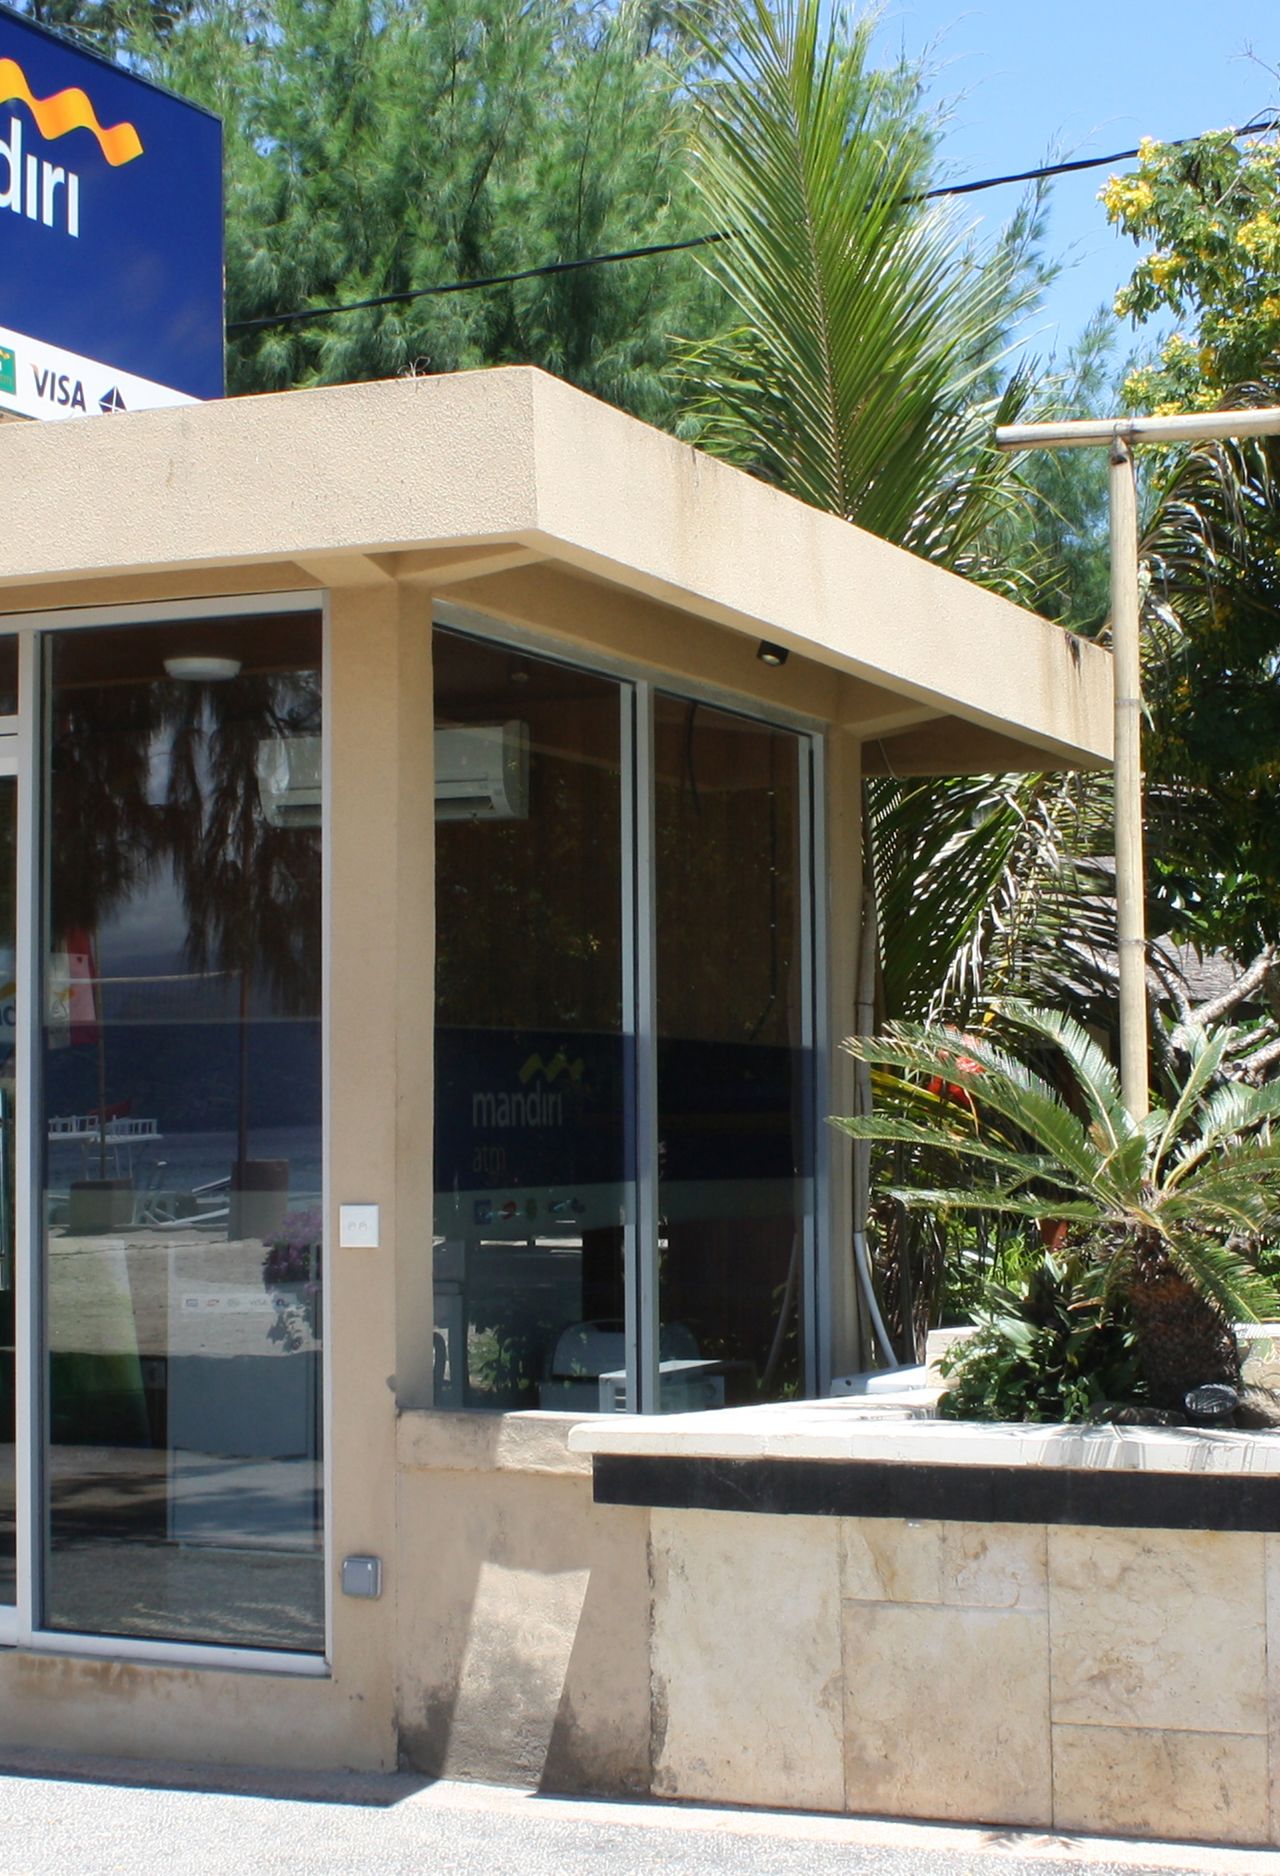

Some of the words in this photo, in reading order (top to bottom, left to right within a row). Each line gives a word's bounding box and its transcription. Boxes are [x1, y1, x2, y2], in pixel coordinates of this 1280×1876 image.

[30, 363, 87, 413] VISA
[472, 1081, 563, 1129] mandiri
[472, 1143, 508, 1175] atm
